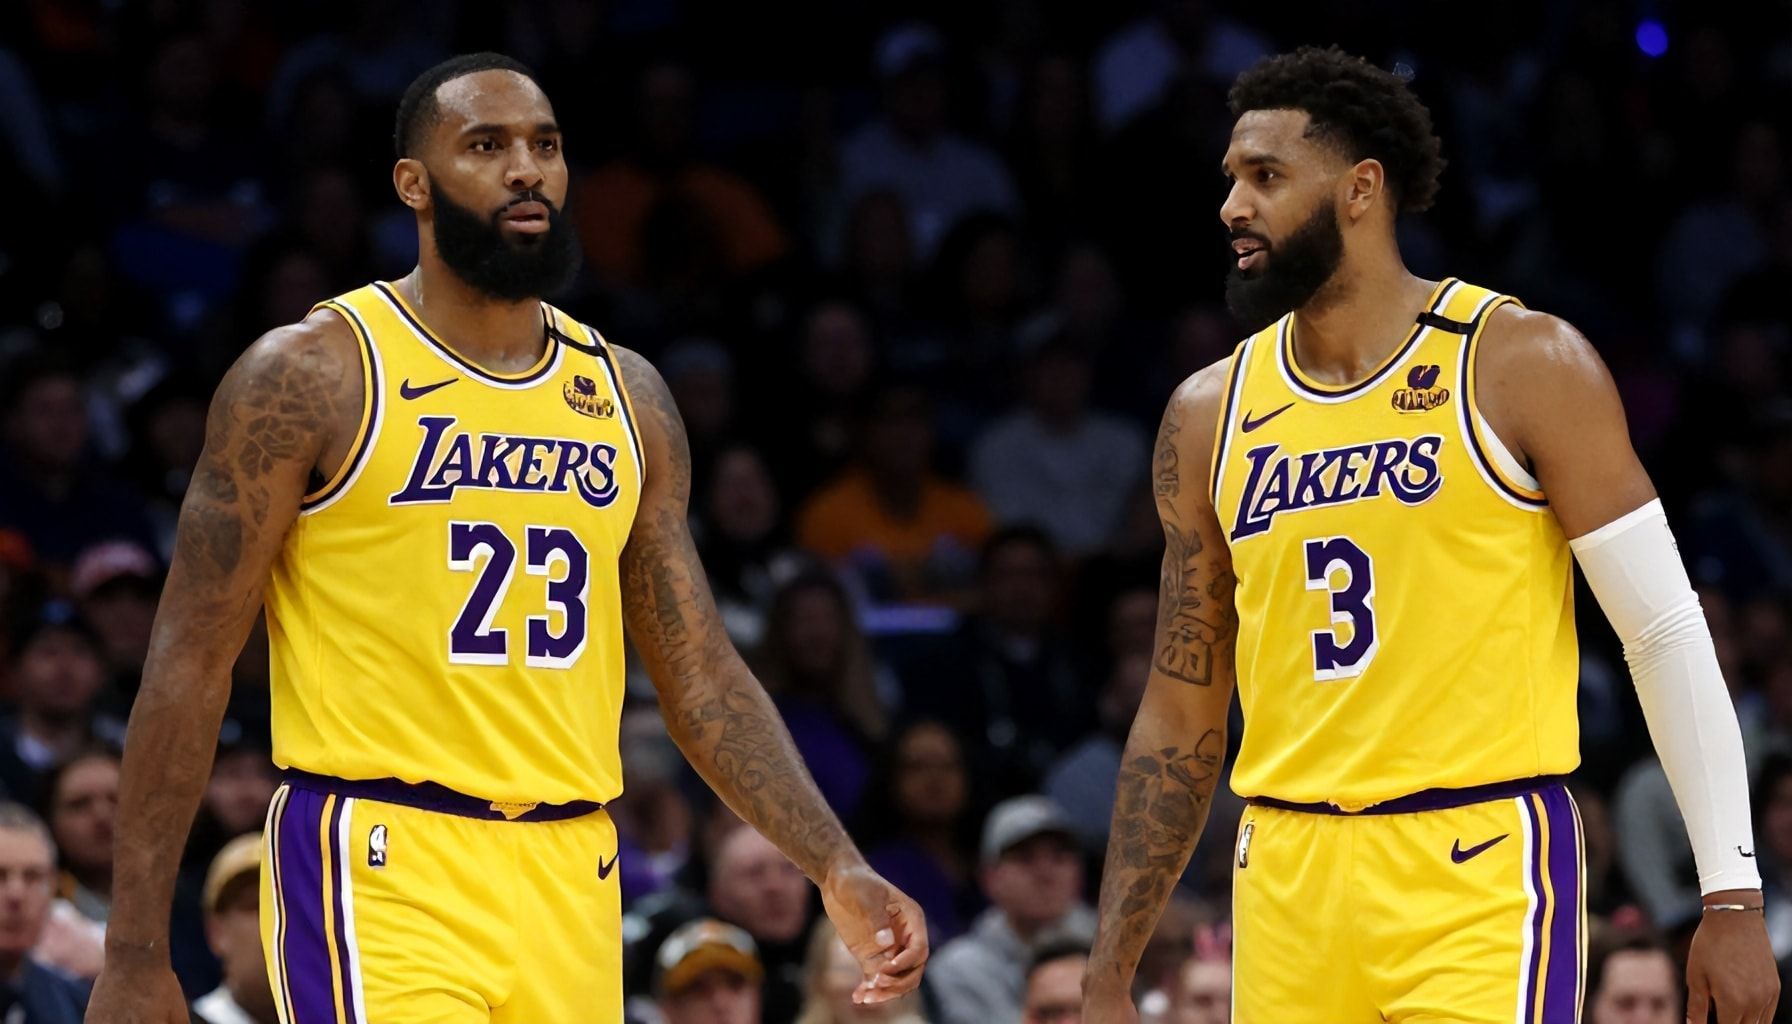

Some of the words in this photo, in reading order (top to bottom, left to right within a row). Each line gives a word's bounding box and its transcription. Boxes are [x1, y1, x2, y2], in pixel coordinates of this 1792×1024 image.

[389, 416, 620, 508] LAKERS
[1231, 435, 1445, 543] LAKERS
[448, 521, 590, 668] 23
[1303, 536, 1380, 681] 3
